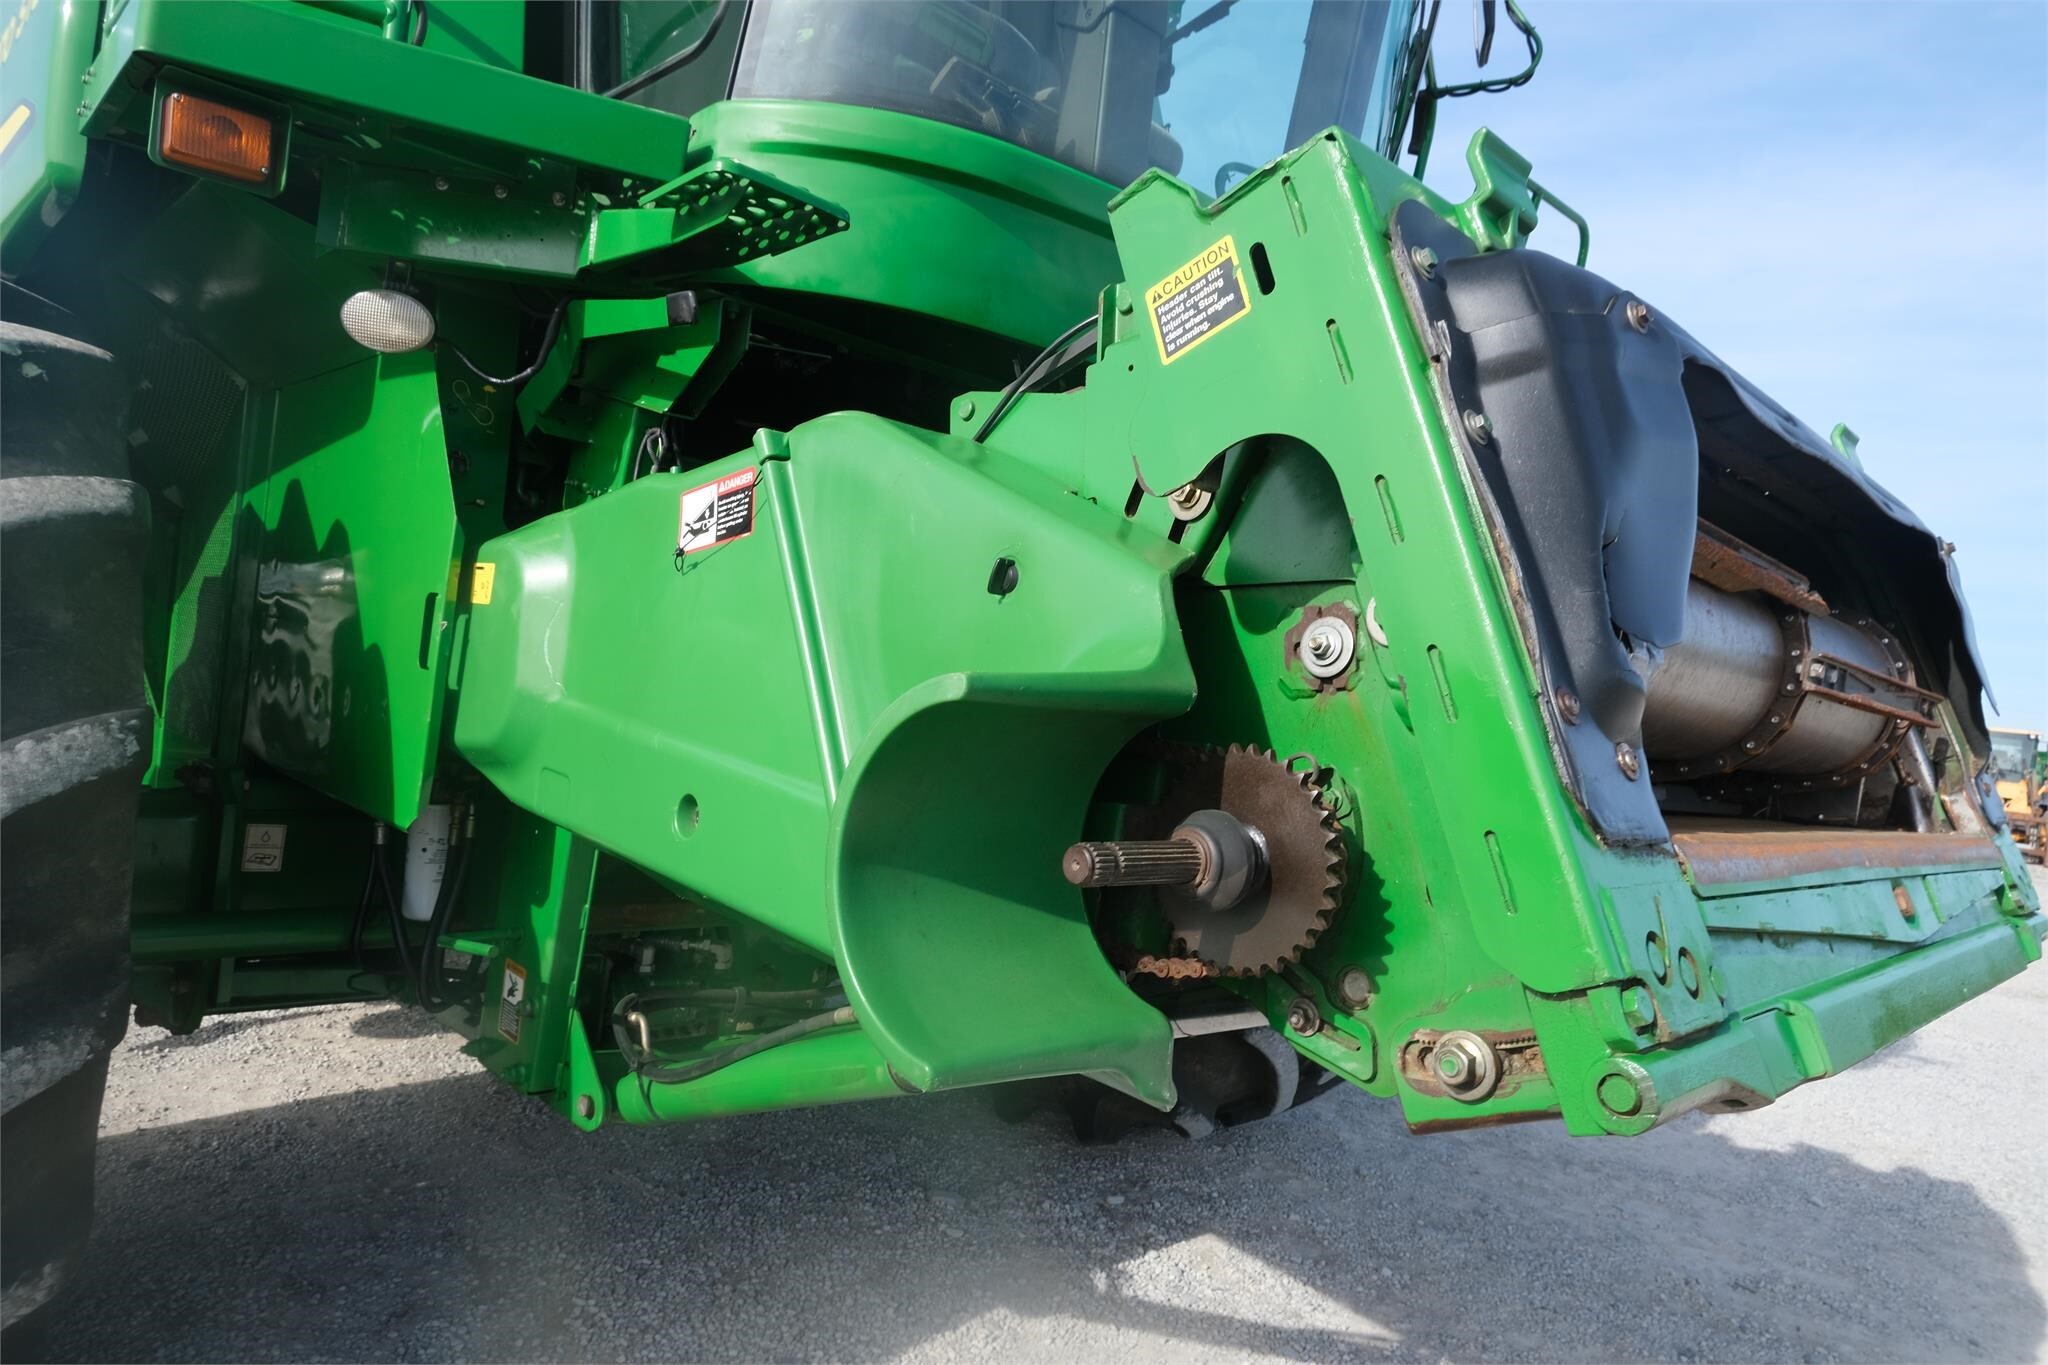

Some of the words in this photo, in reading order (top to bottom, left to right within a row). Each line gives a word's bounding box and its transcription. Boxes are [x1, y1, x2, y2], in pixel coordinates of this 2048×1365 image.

[1157, 290, 1188, 316] Header
[1189, 279, 1207, 294] can
[1207, 267, 1224, 281] tilt.
[1162, 241, 1230, 295] CAUTION
[1160, 303, 1185, 325] Avoid
[1186, 278, 1224, 308] crushing
[1165, 326, 1184, 343] clear
[1184, 311, 1207, 330] when
[1206, 292, 1235, 316] engine
[1198, 291, 1219, 311] Stay
[1167, 342, 1176, 353] is
[1176, 321, 1211, 348] running.
[724, 471, 753, 489] DANGER
